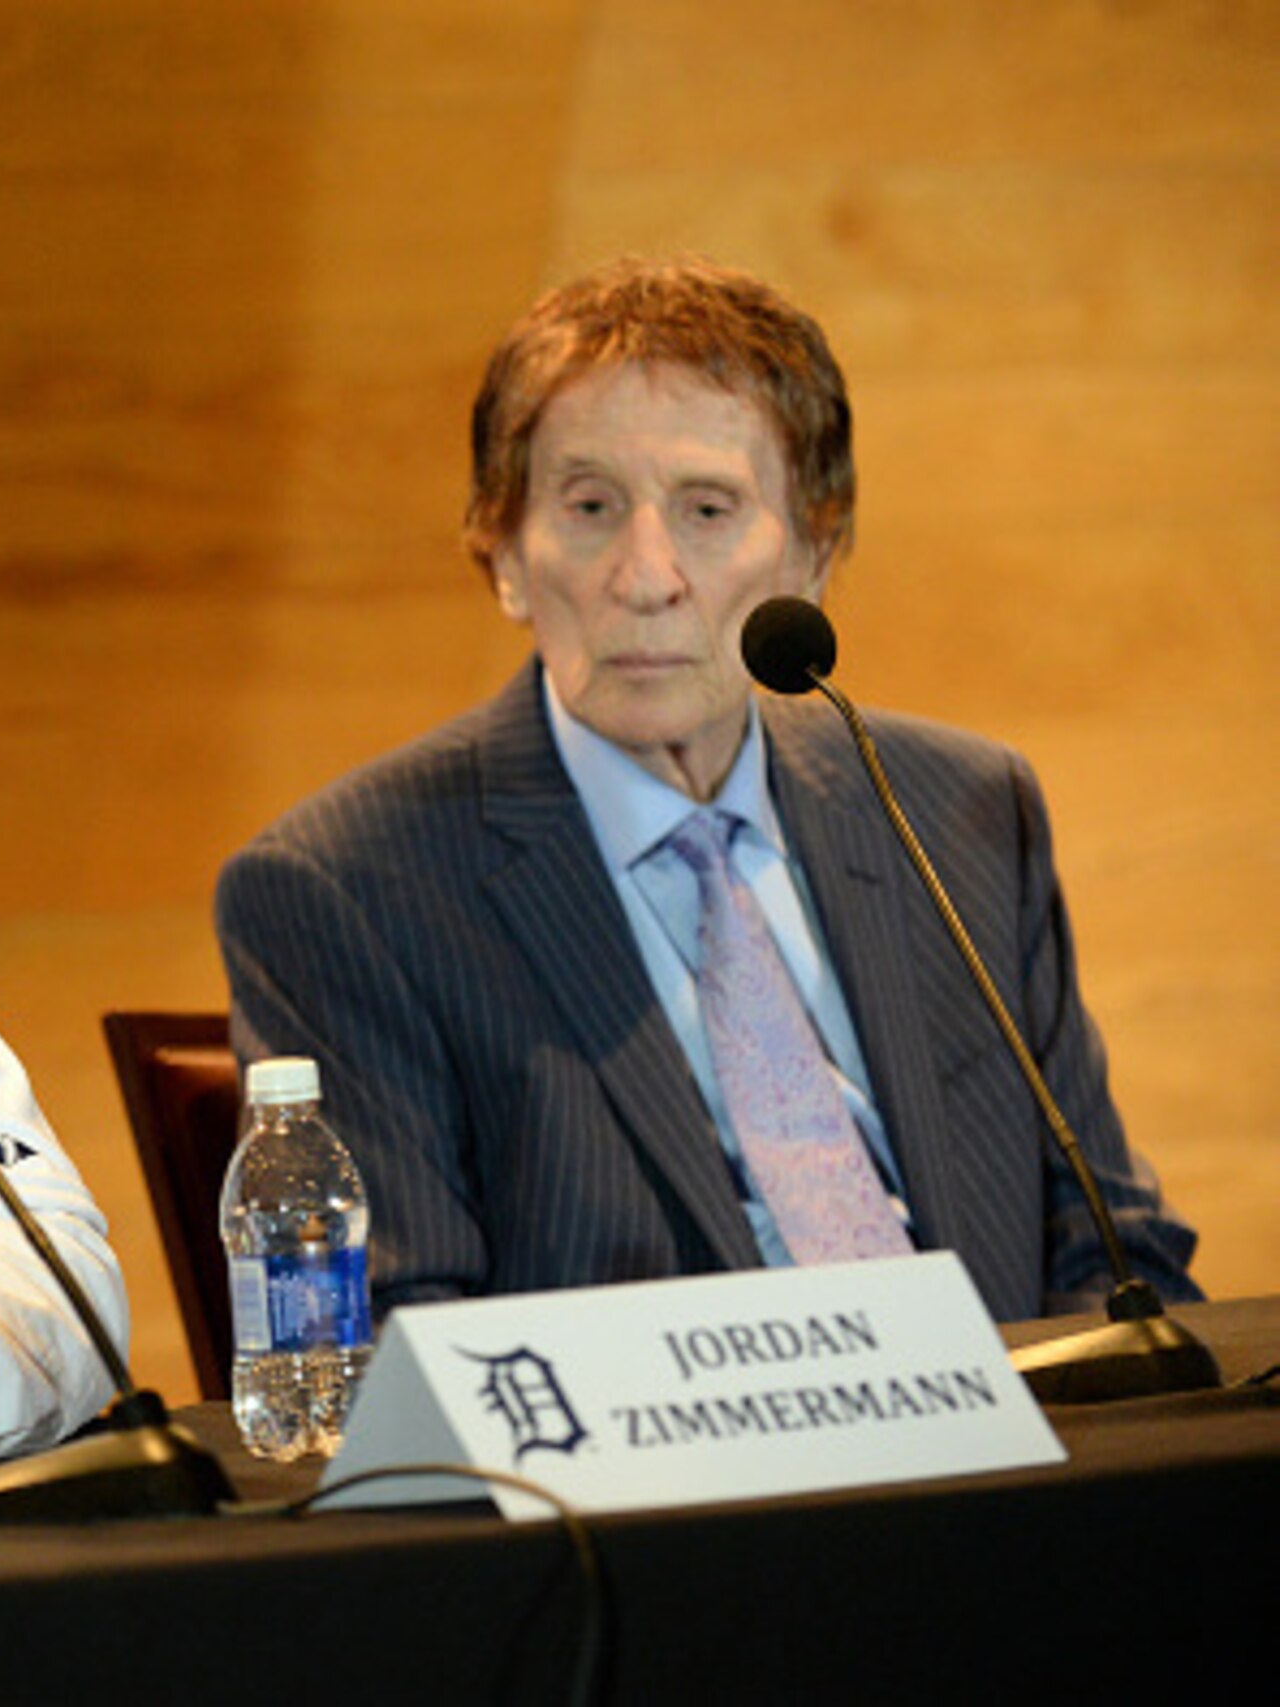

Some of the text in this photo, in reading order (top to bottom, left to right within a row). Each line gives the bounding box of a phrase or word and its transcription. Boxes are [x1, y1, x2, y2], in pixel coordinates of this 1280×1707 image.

[664, 1311, 878, 1379] JORDAN
[453, 1346, 588, 1461] D
[611, 1368, 998, 1448] ZIMMERMANN
